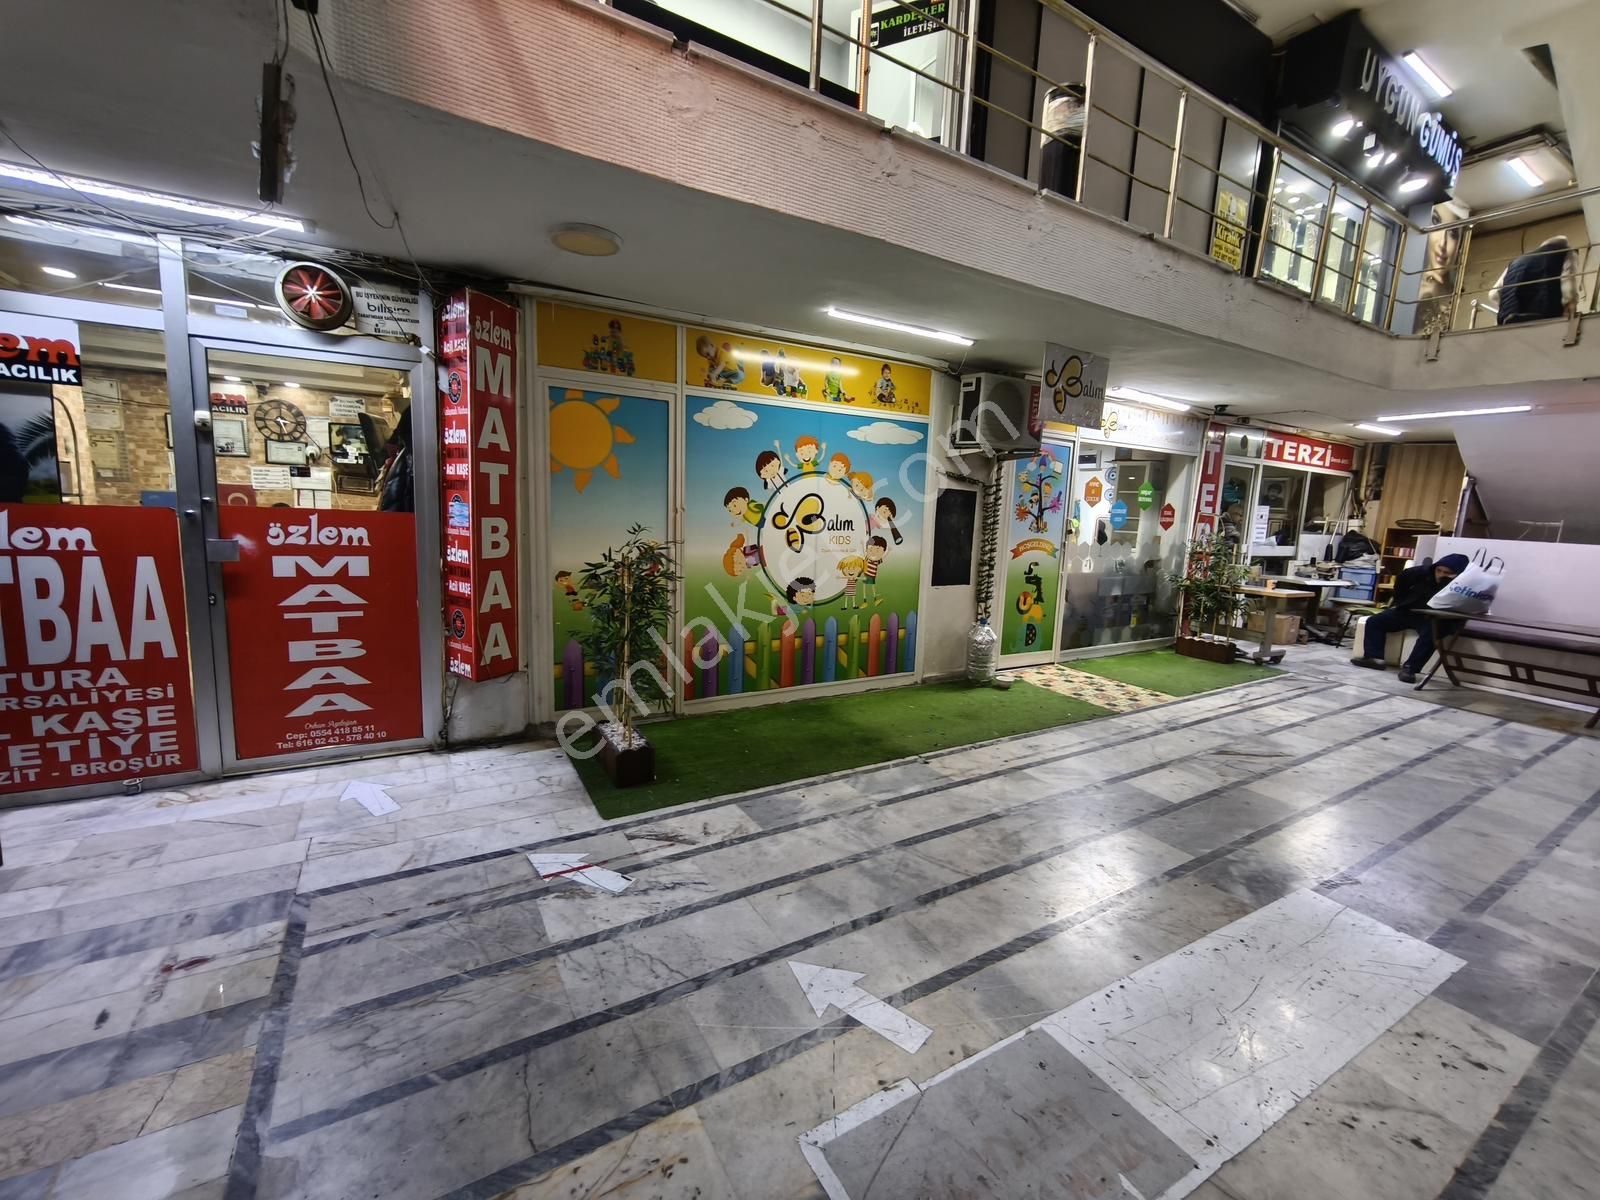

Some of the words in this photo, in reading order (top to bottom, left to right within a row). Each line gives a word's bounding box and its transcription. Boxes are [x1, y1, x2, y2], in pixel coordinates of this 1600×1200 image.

[1361, 47, 1421, 137] UYGUN
[1419, 112, 1463, 187] GÜMÜŞ
[474, 311, 513, 352] özlem
[1266, 438, 1333, 468] TERZİ
[475, 345, 514, 668] MATBAA
[266, 512, 373, 547] özlem
[828, 535, 852, 545] KIDS
[446, 540, 470, 565] özlem
[271, 555, 375, 719] MATBAA
[449, 653, 472, 679] özlem
[31, 704, 177, 737] KAŞE
[310, 729, 333, 738] 0554
[365, 724, 376, 732] 11
[327, 736, 340, 744] 43
[363, 732, 375, 740] 40
[71, 753, 182, 777] BROŞÜR
